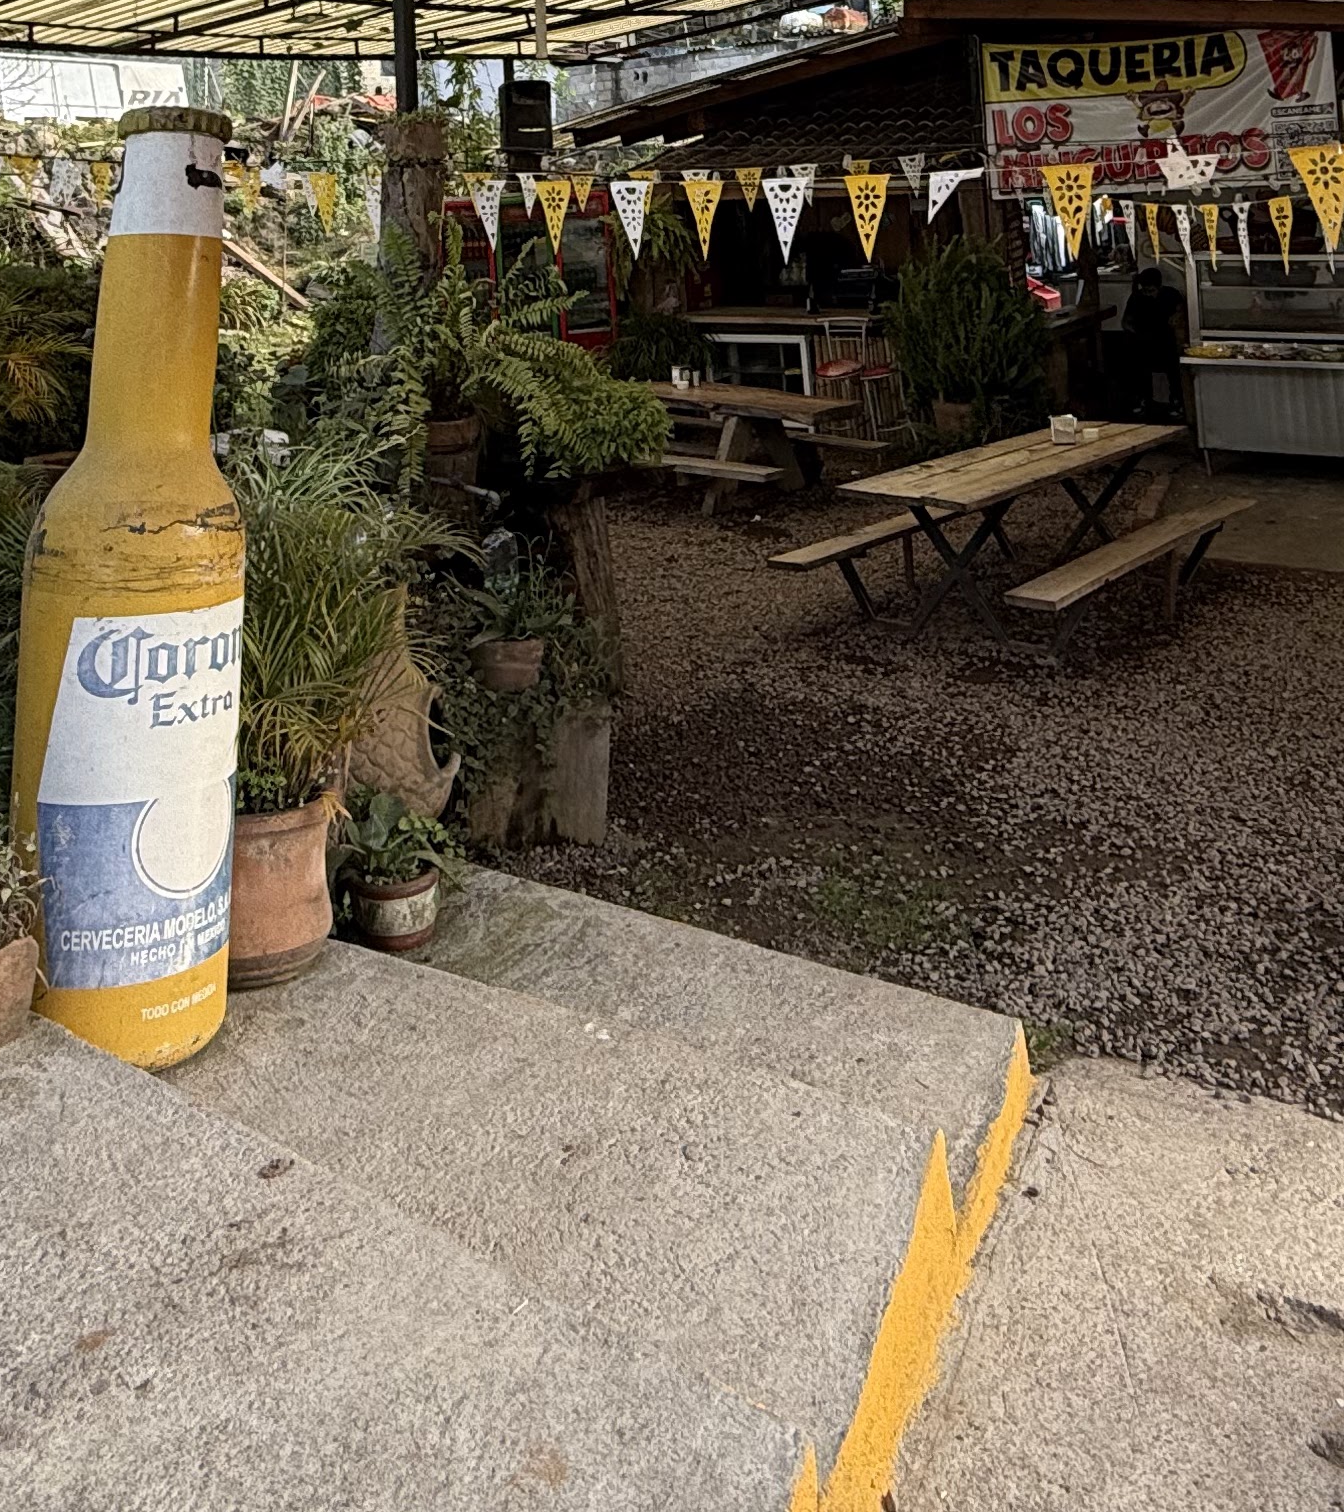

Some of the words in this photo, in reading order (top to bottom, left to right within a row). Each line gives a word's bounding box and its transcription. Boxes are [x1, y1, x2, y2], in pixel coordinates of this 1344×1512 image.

[989, 34, 1236, 92] TAQUERIA
[992, 103, 1072, 145] LOS
[76, 624, 242, 706] Coron
[149, 690, 233, 729] Extra
[61, 922, 160, 952] CERVECERIA
[130, 943, 177, 967] HECHO
[140, 1003, 169, 1022] TODO
